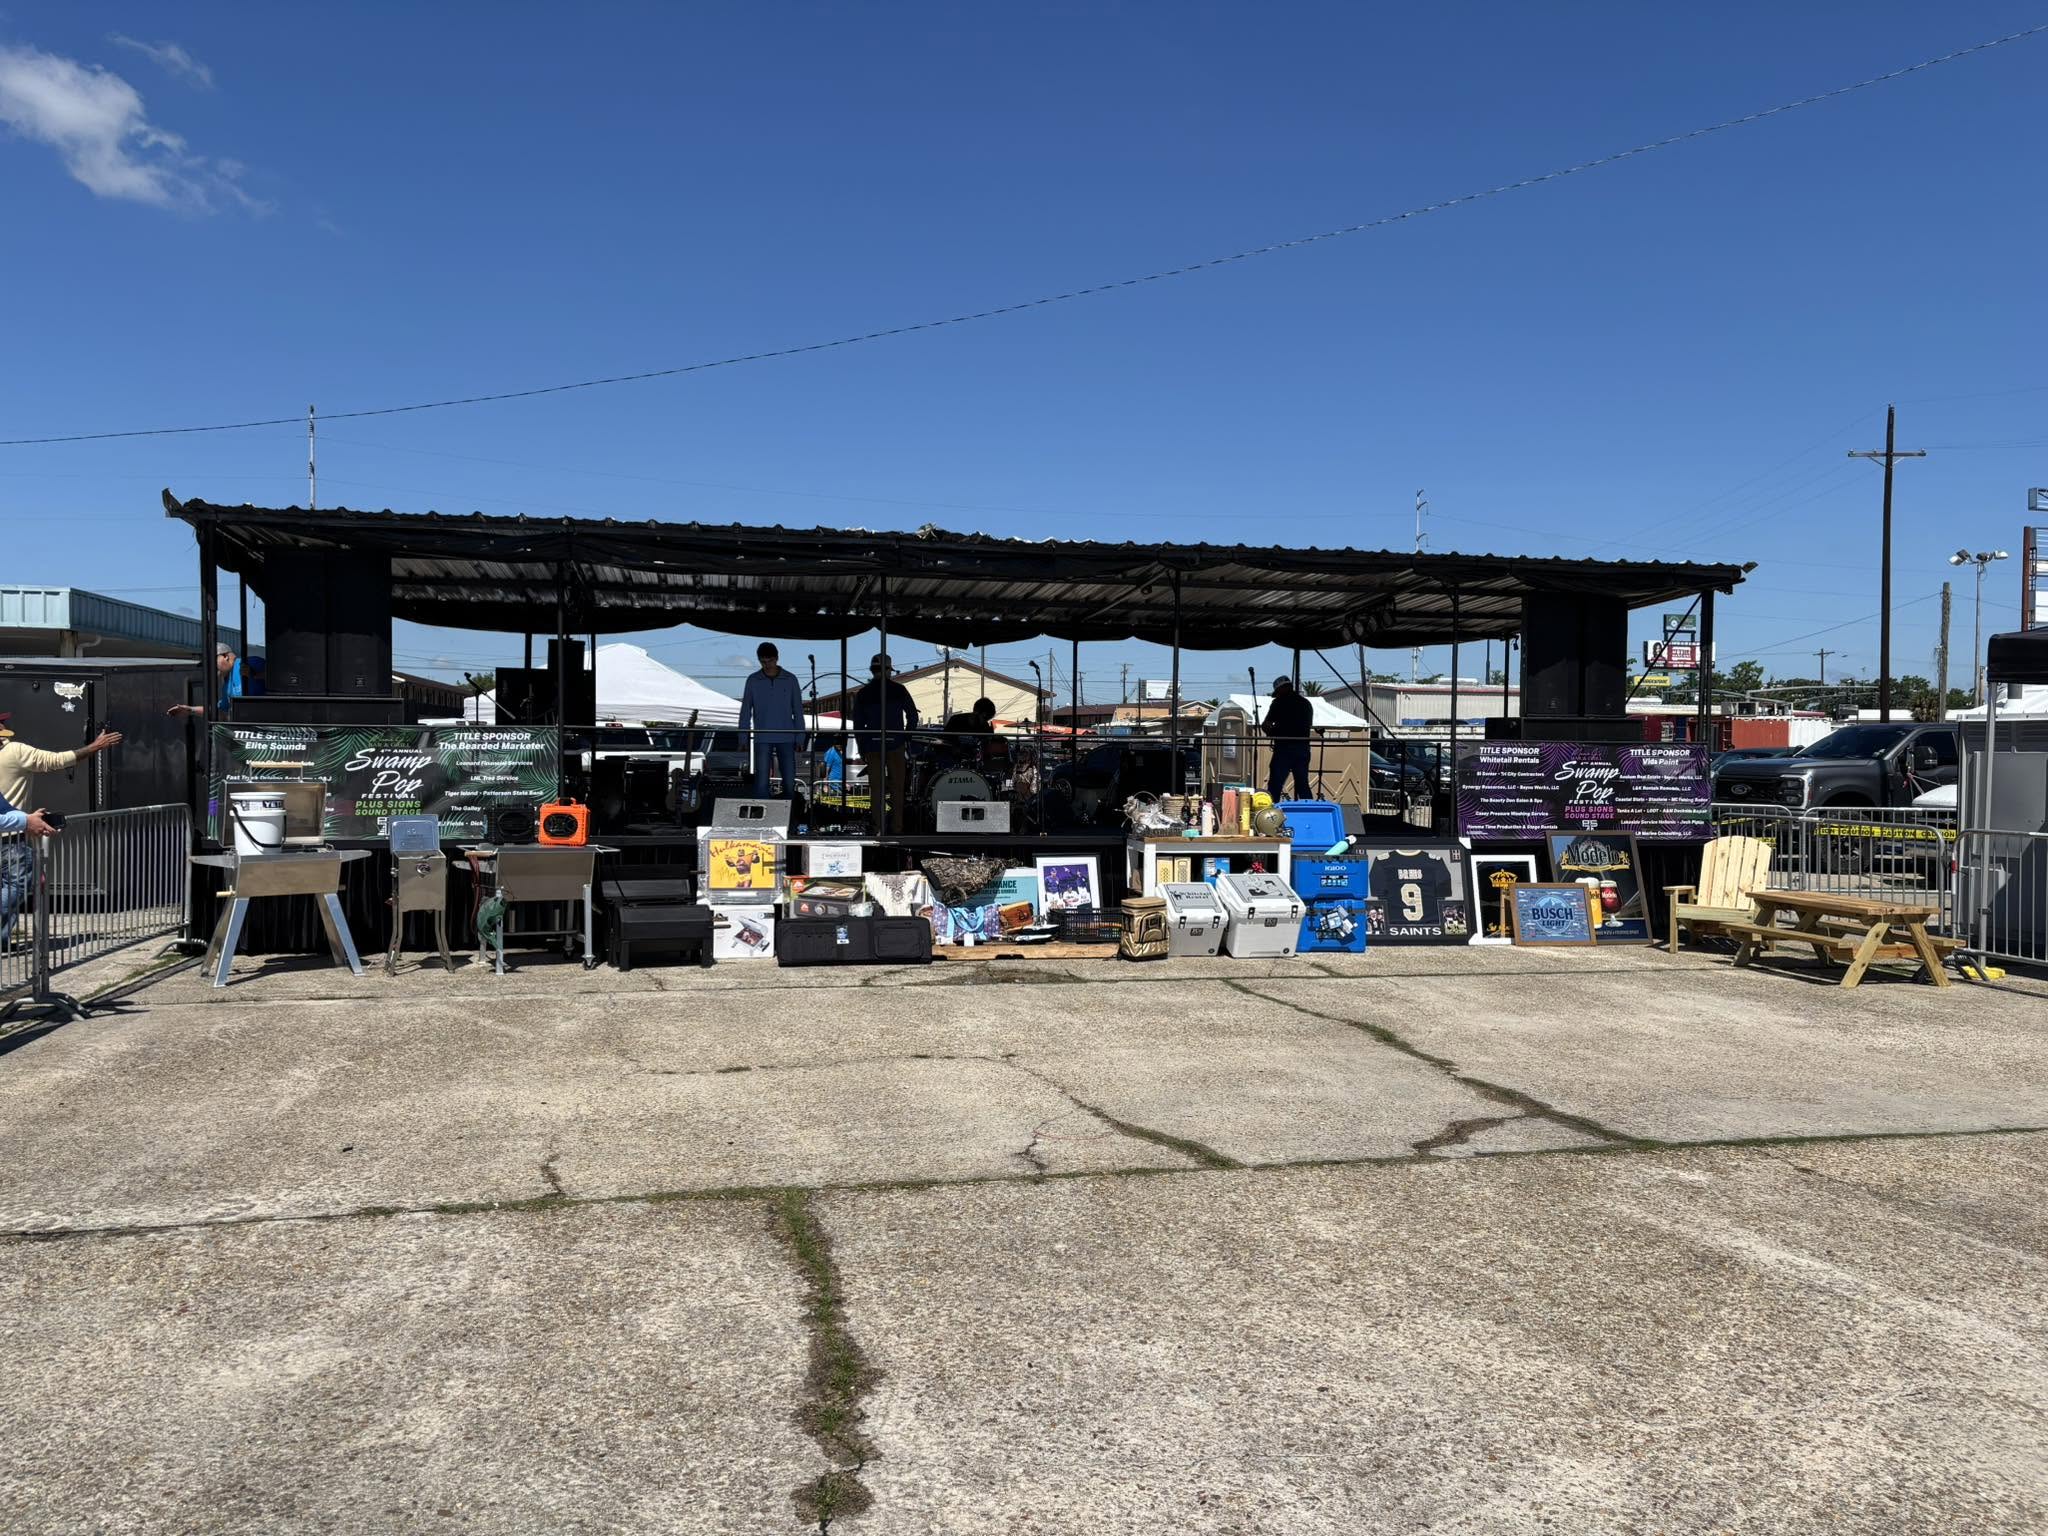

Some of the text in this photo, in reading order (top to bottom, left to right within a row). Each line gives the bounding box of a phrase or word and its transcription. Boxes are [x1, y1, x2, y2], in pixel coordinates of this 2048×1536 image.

[233, 730, 318, 742] TITLE SPONSOR
[454, 732, 531, 740] TITLE SPONSOR
[245, 741, 306, 751] Elite Sounds
[439, 742, 546, 750] The Bearded Marketer
[345, 747, 434, 776] Swamp
[1659, 758, 1679, 766] Paint
[1555, 760, 1620, 784] Swamp
[372, 770, 424, 796] Pop
[1576, 780, 1615, 802] Pop
[355, 801, 422, 809] PLUS SIGNS
[1567, 844, 1621, 866] Modelo
[1401, 883, 1424, 921] 9
[1531, 907, 1573, 920] BUSCH
[1389, 927, 1442, 936] SAINTS
